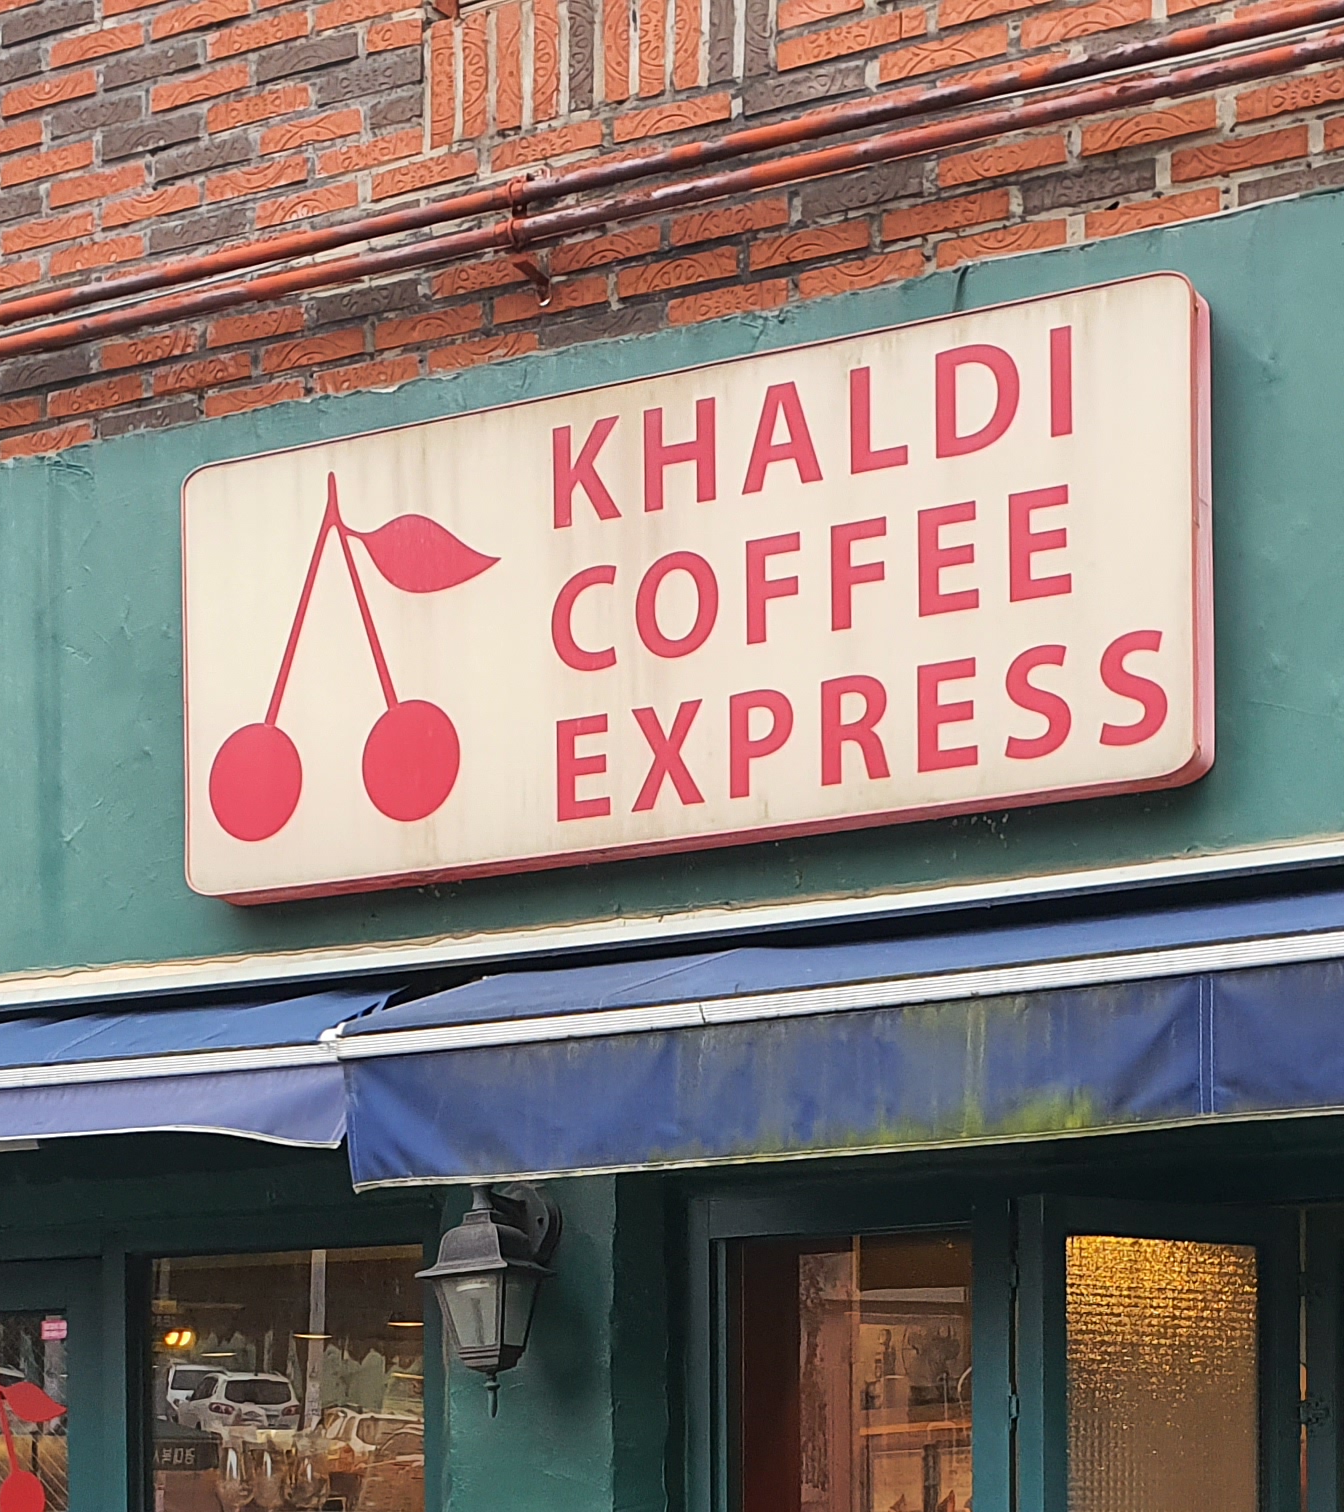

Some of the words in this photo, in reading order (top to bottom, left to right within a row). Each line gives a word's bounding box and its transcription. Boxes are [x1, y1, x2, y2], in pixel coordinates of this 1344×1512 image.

[552, 325, 1073, 529] KHALDI
[551, 484, 1072, 671] COFFEE
[556, 629, 1169, 822] EXPRESS
